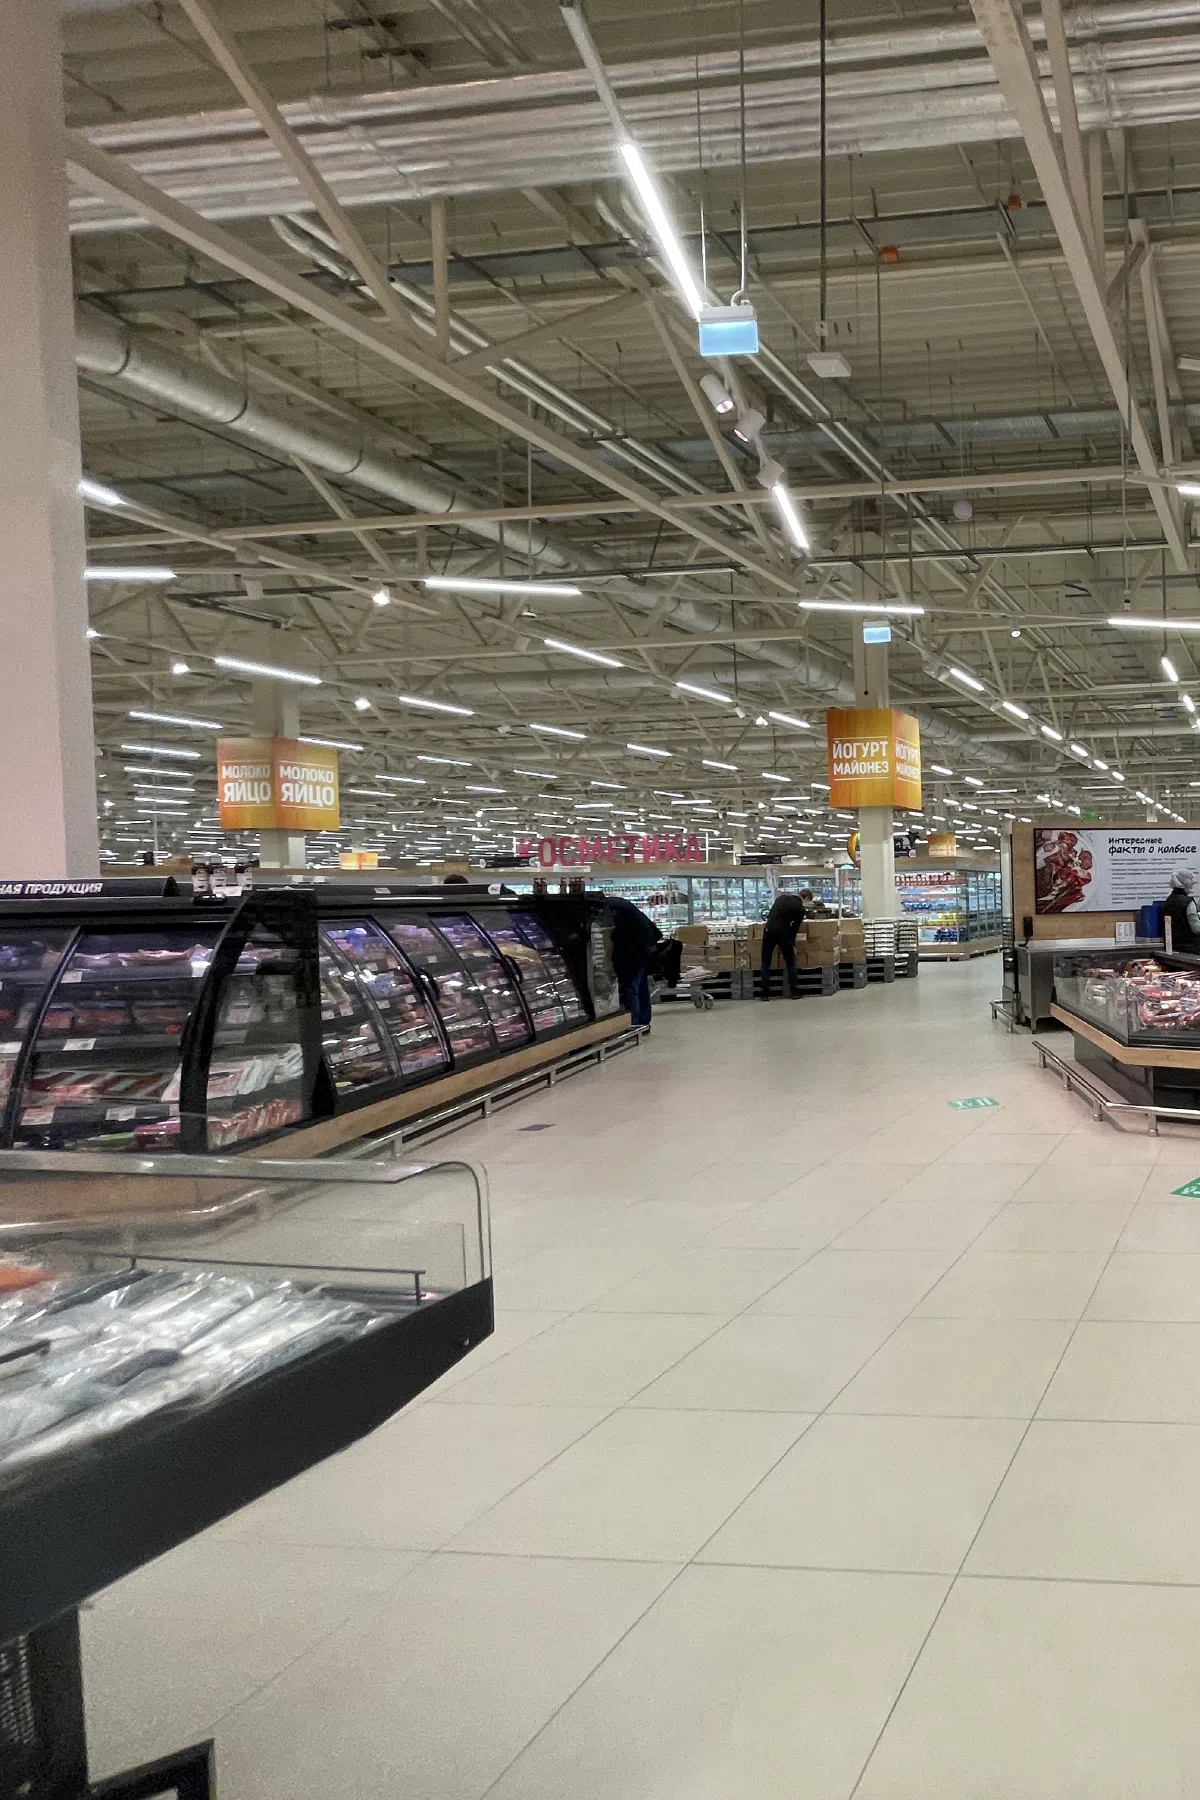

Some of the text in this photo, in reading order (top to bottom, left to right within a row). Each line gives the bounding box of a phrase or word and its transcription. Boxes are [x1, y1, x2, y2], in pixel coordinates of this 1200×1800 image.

[832, 740, 889, 760] ЙОГУРТ
[895, 740, 919, 764] ЙОГУРТ
[222, 765, 271, 779] МОЛОКО
[280, 765, 335, 783] МОЛОКО
[833, 760, 889, 775] МАЙОНЕЗ
[223, 780, 272, 803] ЯЙЦО
[281, 782, 335, 807] ЯЙЦО
[519, 833, 702, 867] КОСМЕТИКА
[1108, 845, 1146, 856] факты
[1157, 844, 1197, 855] колбасе
[24, 882, 103, 895] ПРОДУКЦИЯ
